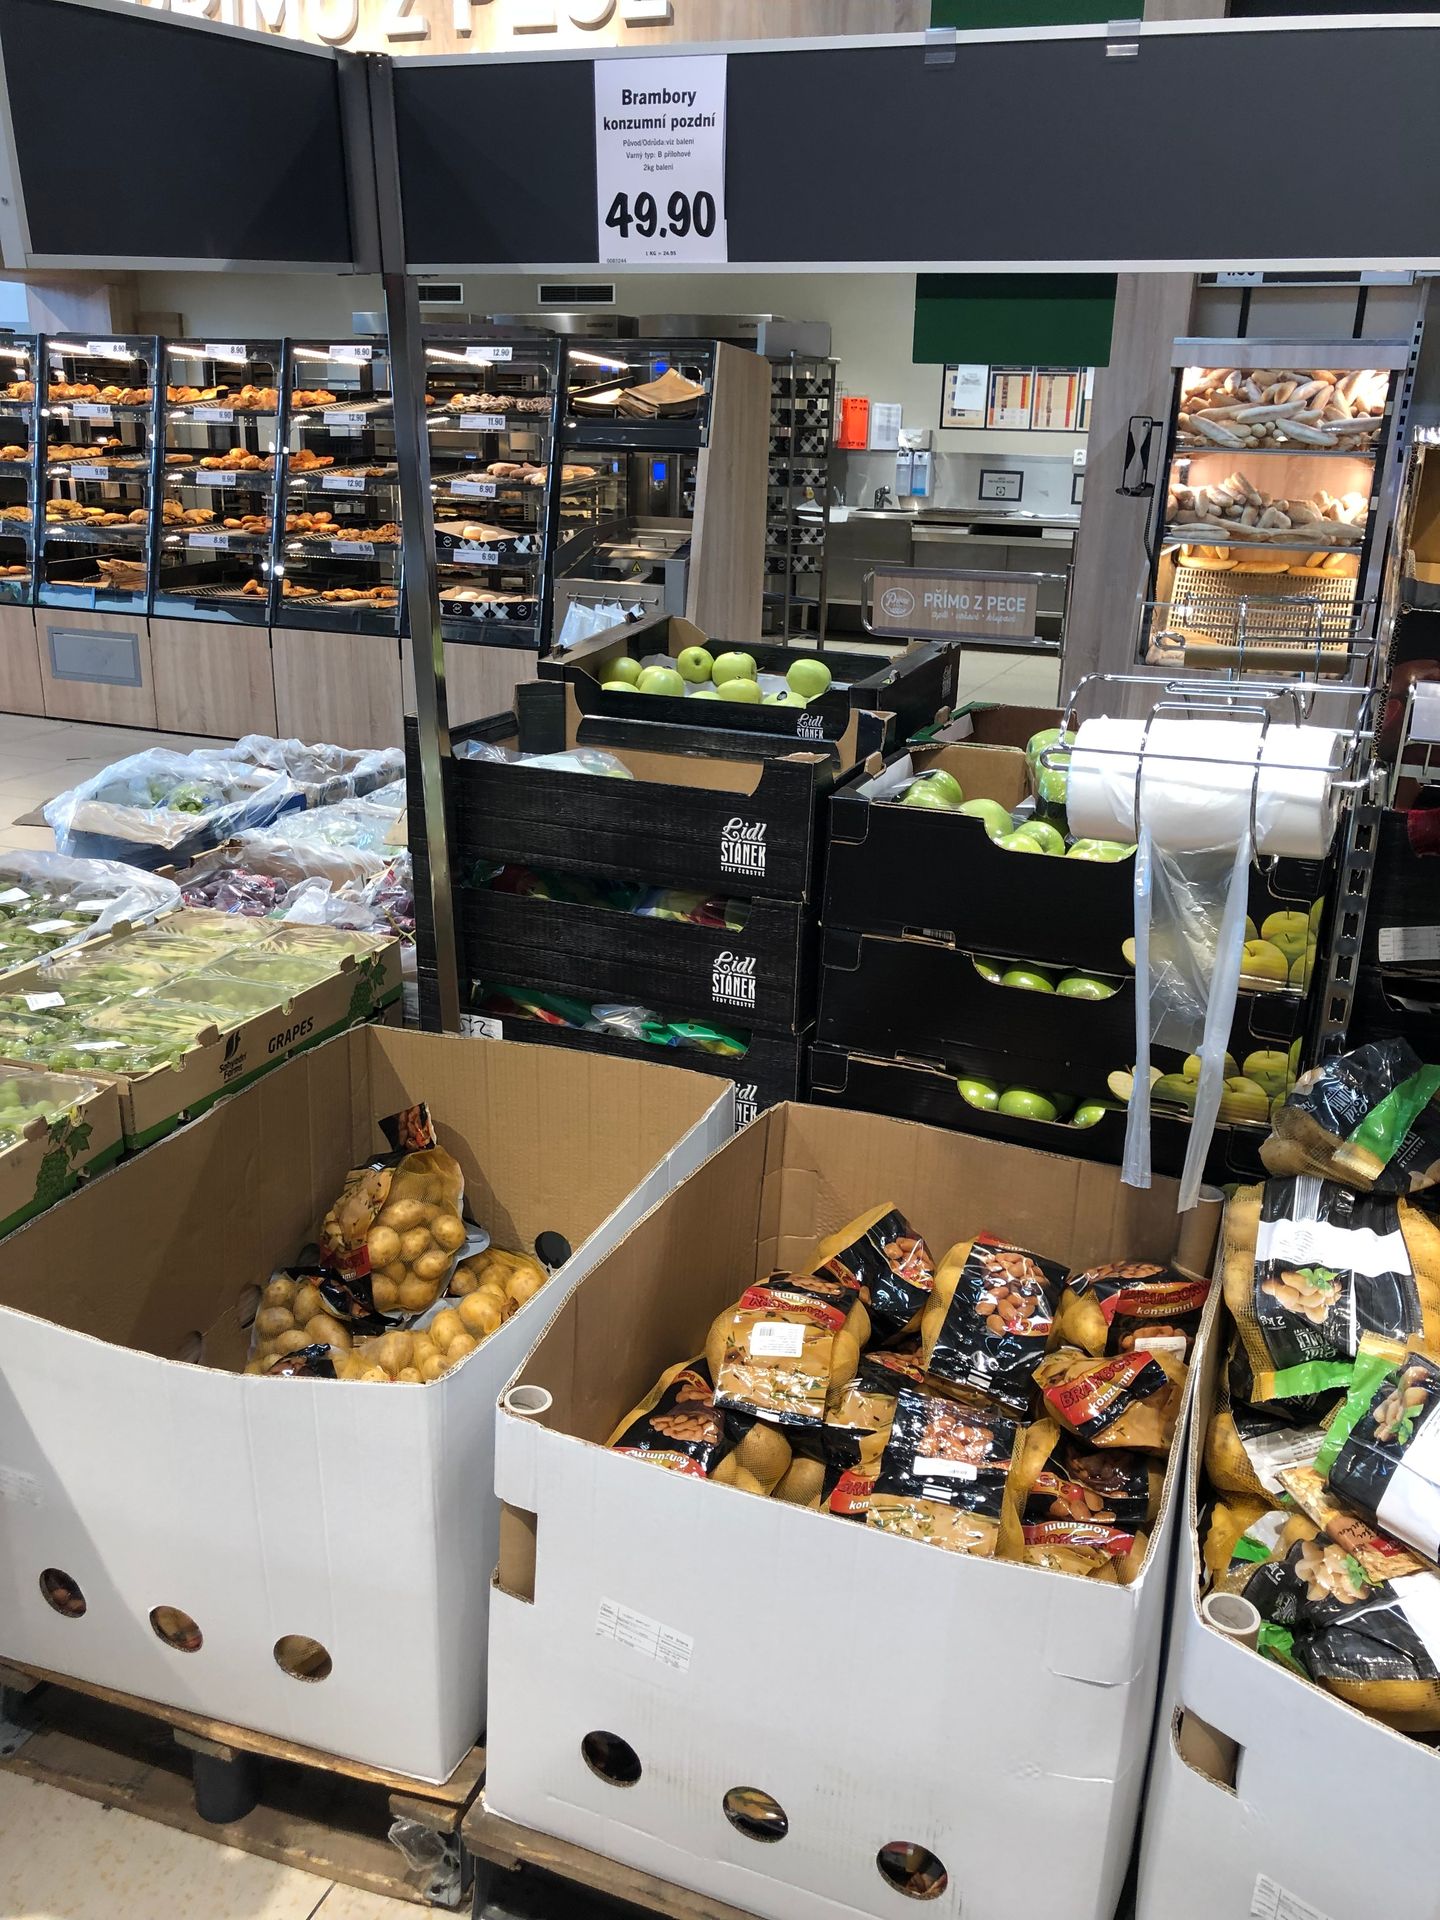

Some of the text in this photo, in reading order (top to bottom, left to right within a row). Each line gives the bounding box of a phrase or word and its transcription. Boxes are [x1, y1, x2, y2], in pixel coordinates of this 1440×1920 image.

[622, 88, 697, 107] Brambory
[603, 112, 716, 131] konzumní pozdní
[658, 150, 662, 158] B
[643, 163, 655, 172] 2kg
[605, 190, 716, 238] 49.90
[230, 346, 243, 354] 8.90
[354, 348, 370, 356] 16.90
[492, 348, 509, 357] 12.90
[96, 406, 109, 414] 9.90
[348, 413, 364, 421] 12.90
[488, 418, 503, 426] 11.90
[347, 480, 362, 488] 12.90
[480, 485, 493, 493] 6.90
[482, 553, 496, 561] 6.90
[924, 589, 969, 610] PŘÍMO
[973, 596, 982, 610] Z
[987, 597, 1026, 613] PECE
[797, 713, 823, 727] Lidl
[721, 817, 767, 841] Lidl
[720, 839, 766, 868] STÁNEK
[712, 951, 757, 975] Lidl
[712, 971, 756, 1000] STÁNEK
[268, 1016, 314, 1054] GRAPES
[1260, 1315, 1286, 1326] 2 kg
[1044, 1522, 1110, 1538] konzumní
